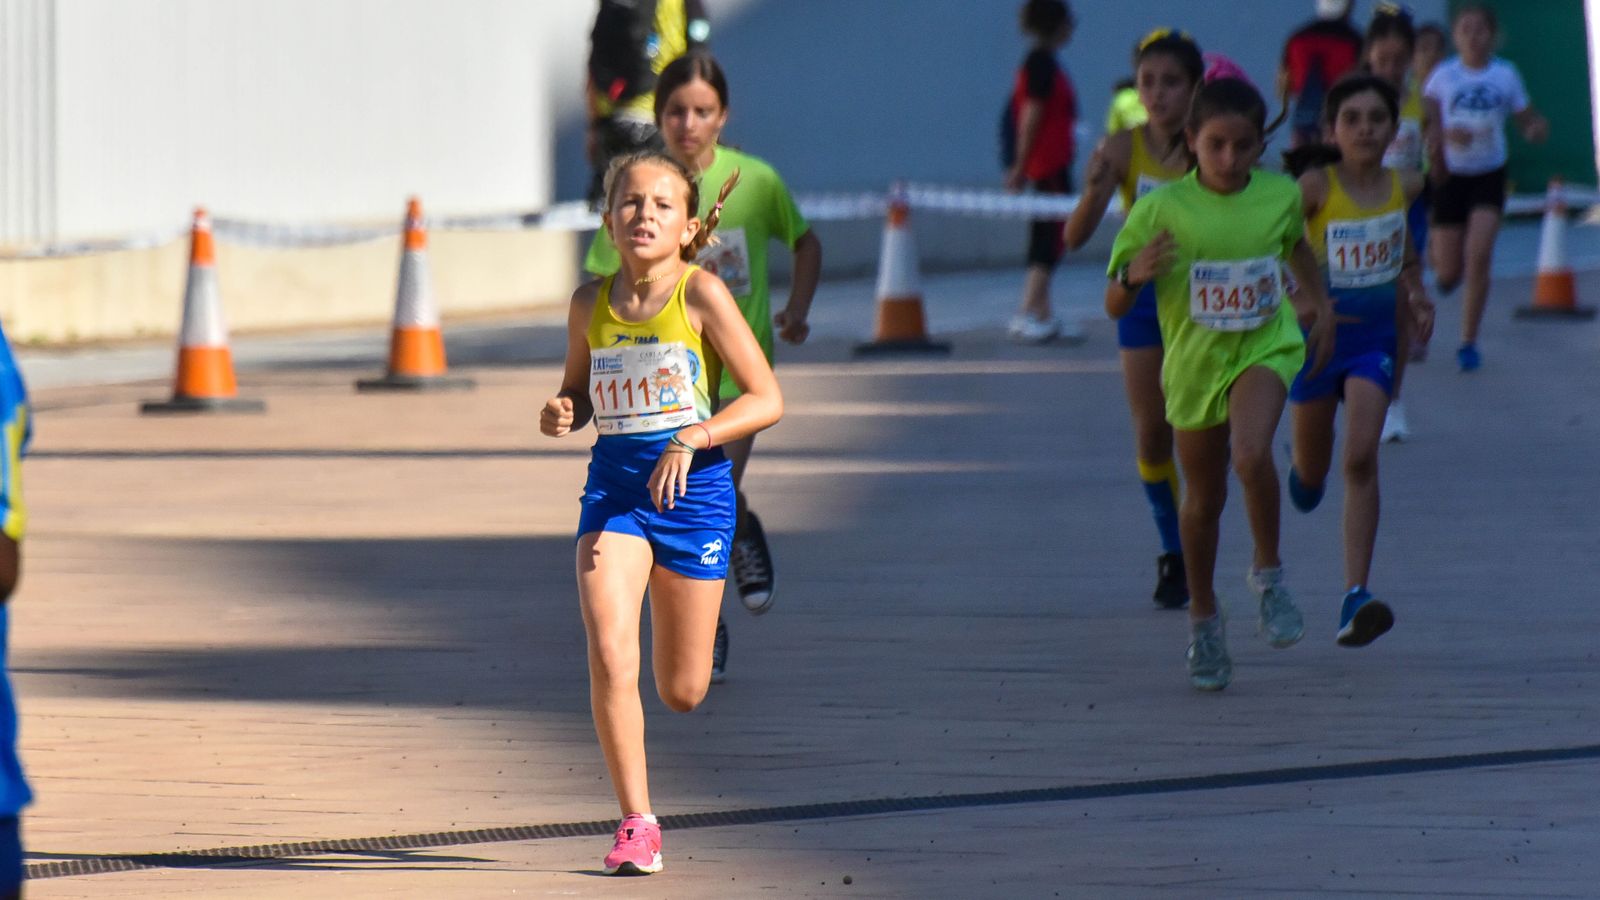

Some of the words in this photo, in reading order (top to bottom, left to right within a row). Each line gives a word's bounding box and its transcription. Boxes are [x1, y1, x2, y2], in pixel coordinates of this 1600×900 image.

[1336, 241, 1388, 270] 1158
[1198, 285, 1256, 312] 1343
[595, 377, 650, 410] 1111
